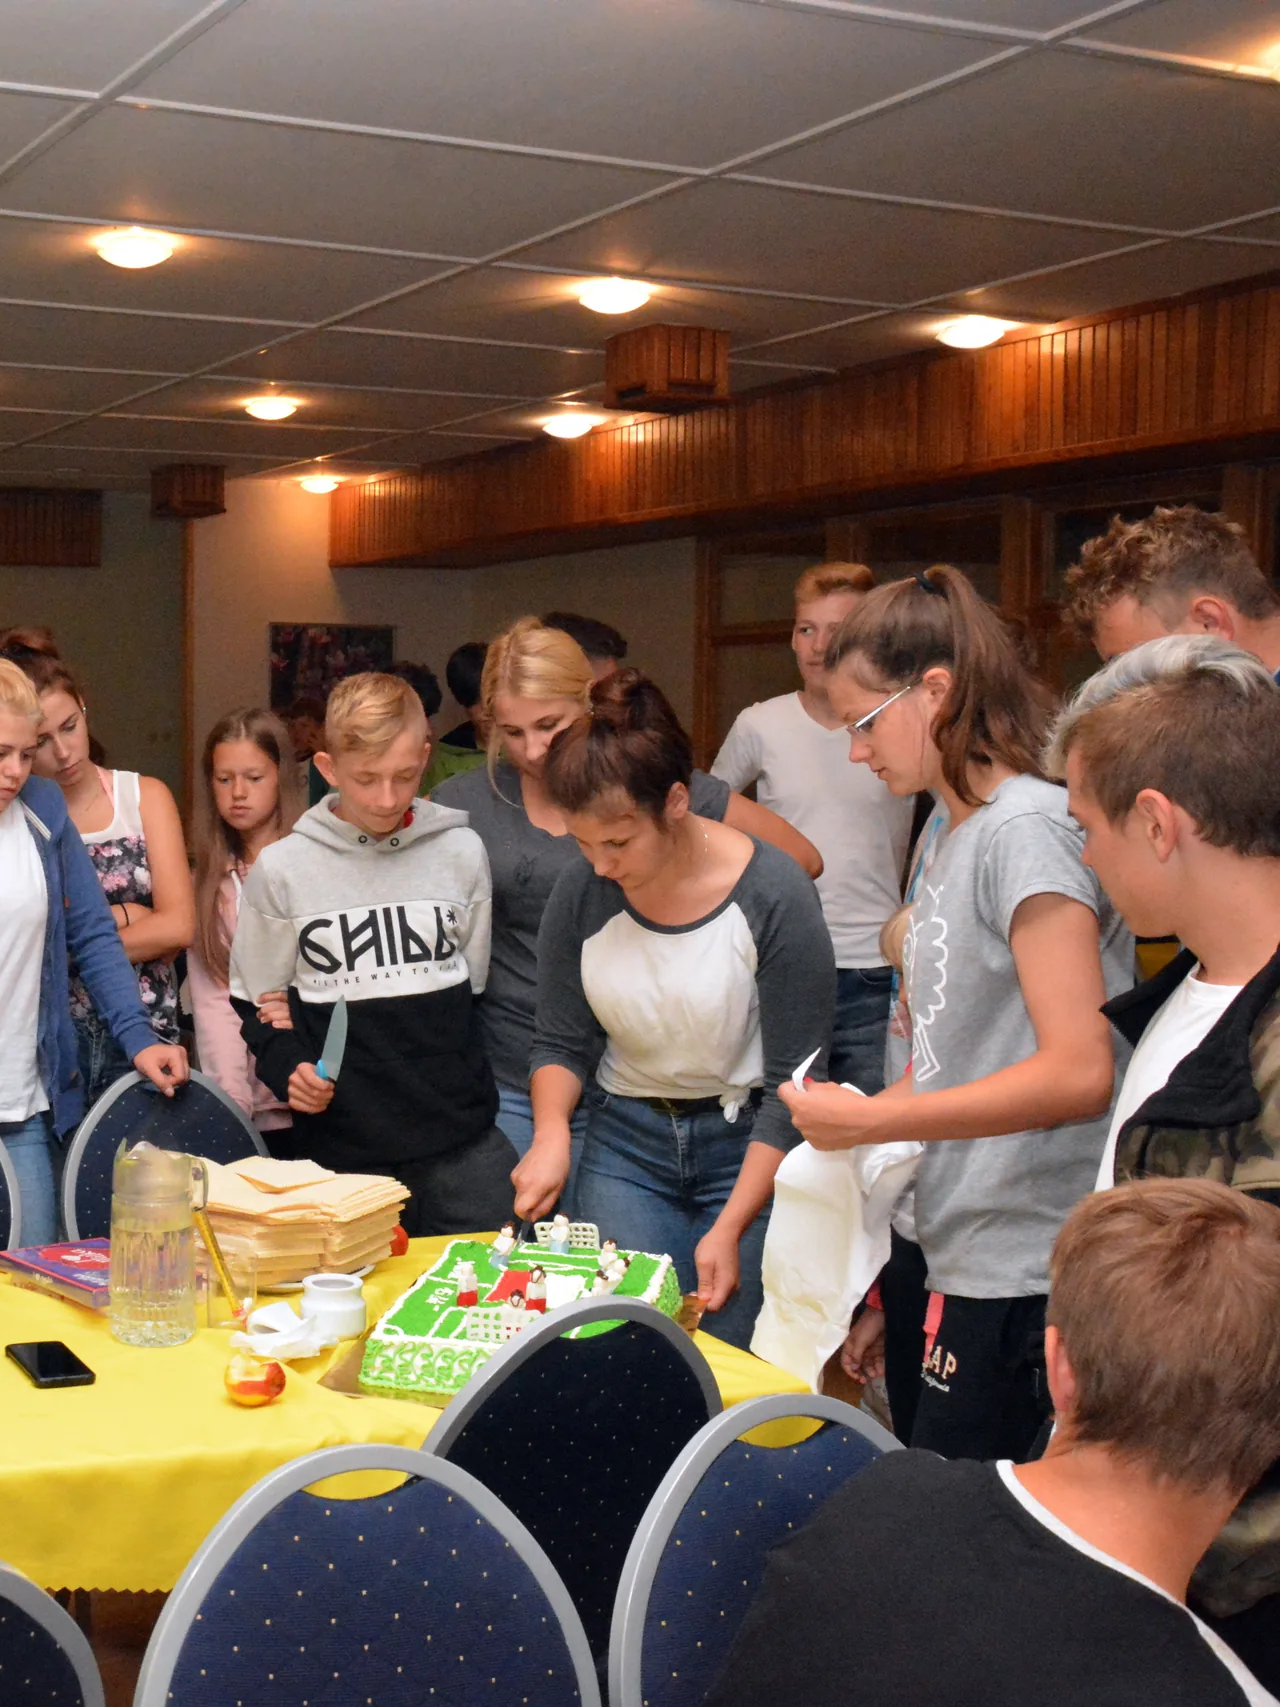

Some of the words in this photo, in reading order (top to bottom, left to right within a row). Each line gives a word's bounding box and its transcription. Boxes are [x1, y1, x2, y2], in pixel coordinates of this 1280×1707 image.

[334, 976, 361, 987] THE
[371, 970, 402, 981] WAY
[412, 966, 429, 975] TO
